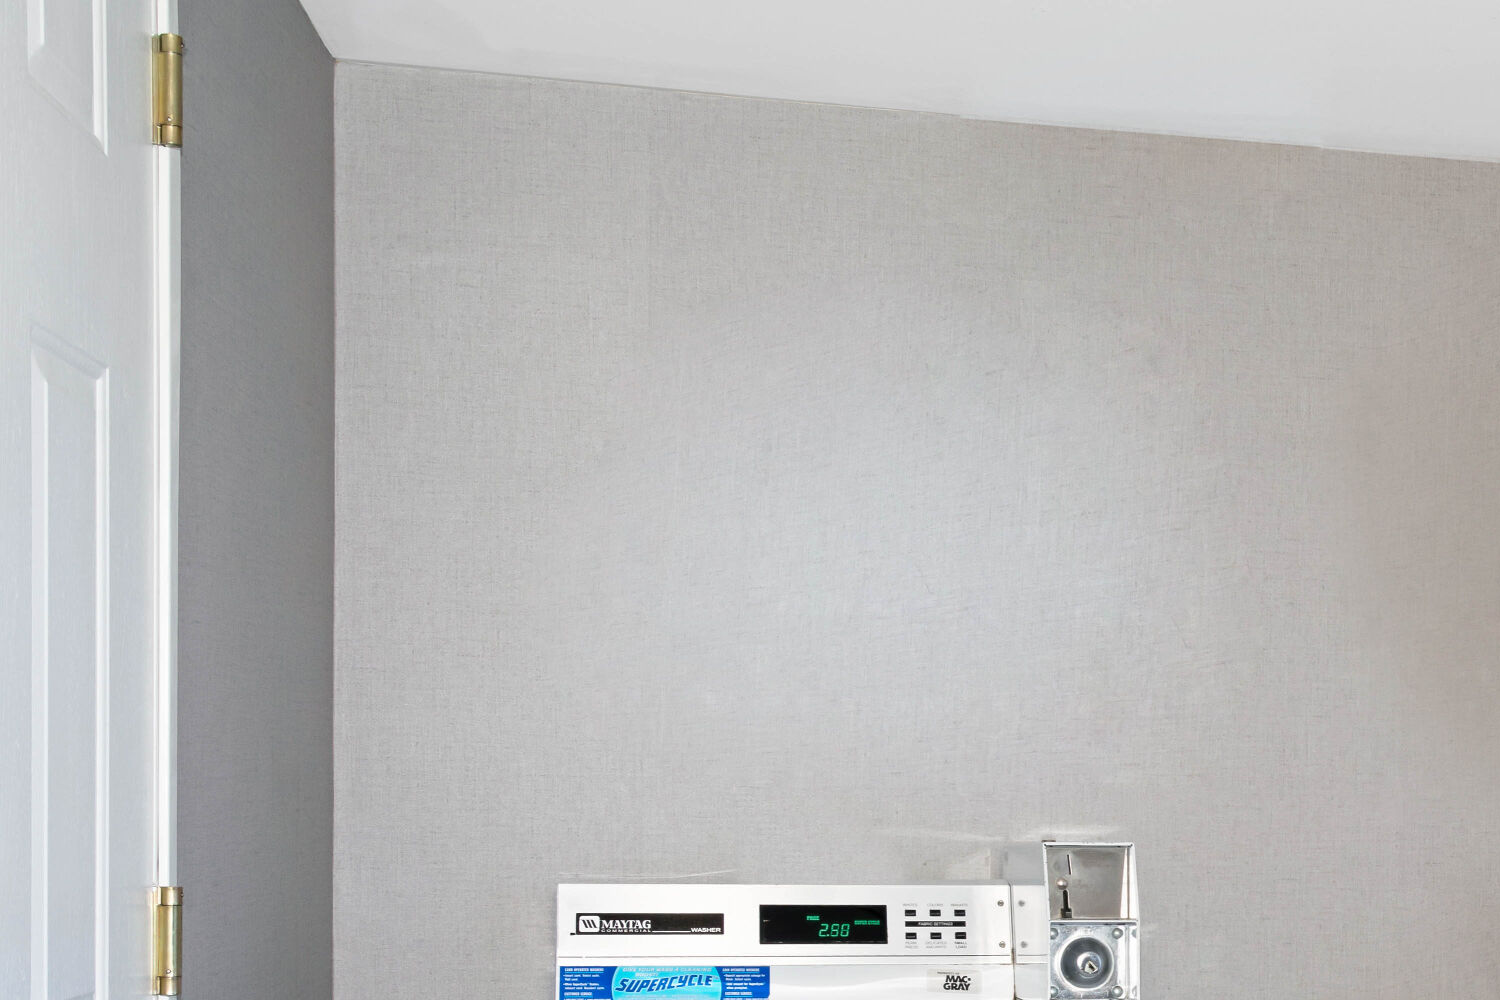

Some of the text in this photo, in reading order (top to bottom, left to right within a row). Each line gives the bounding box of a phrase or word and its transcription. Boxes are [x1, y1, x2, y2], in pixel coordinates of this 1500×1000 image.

[600, 919, 652, 929] MAYTAG
[615, 974, 713, 993] SUPERCYCLE
[943, 982, 971, 991] GRAY
